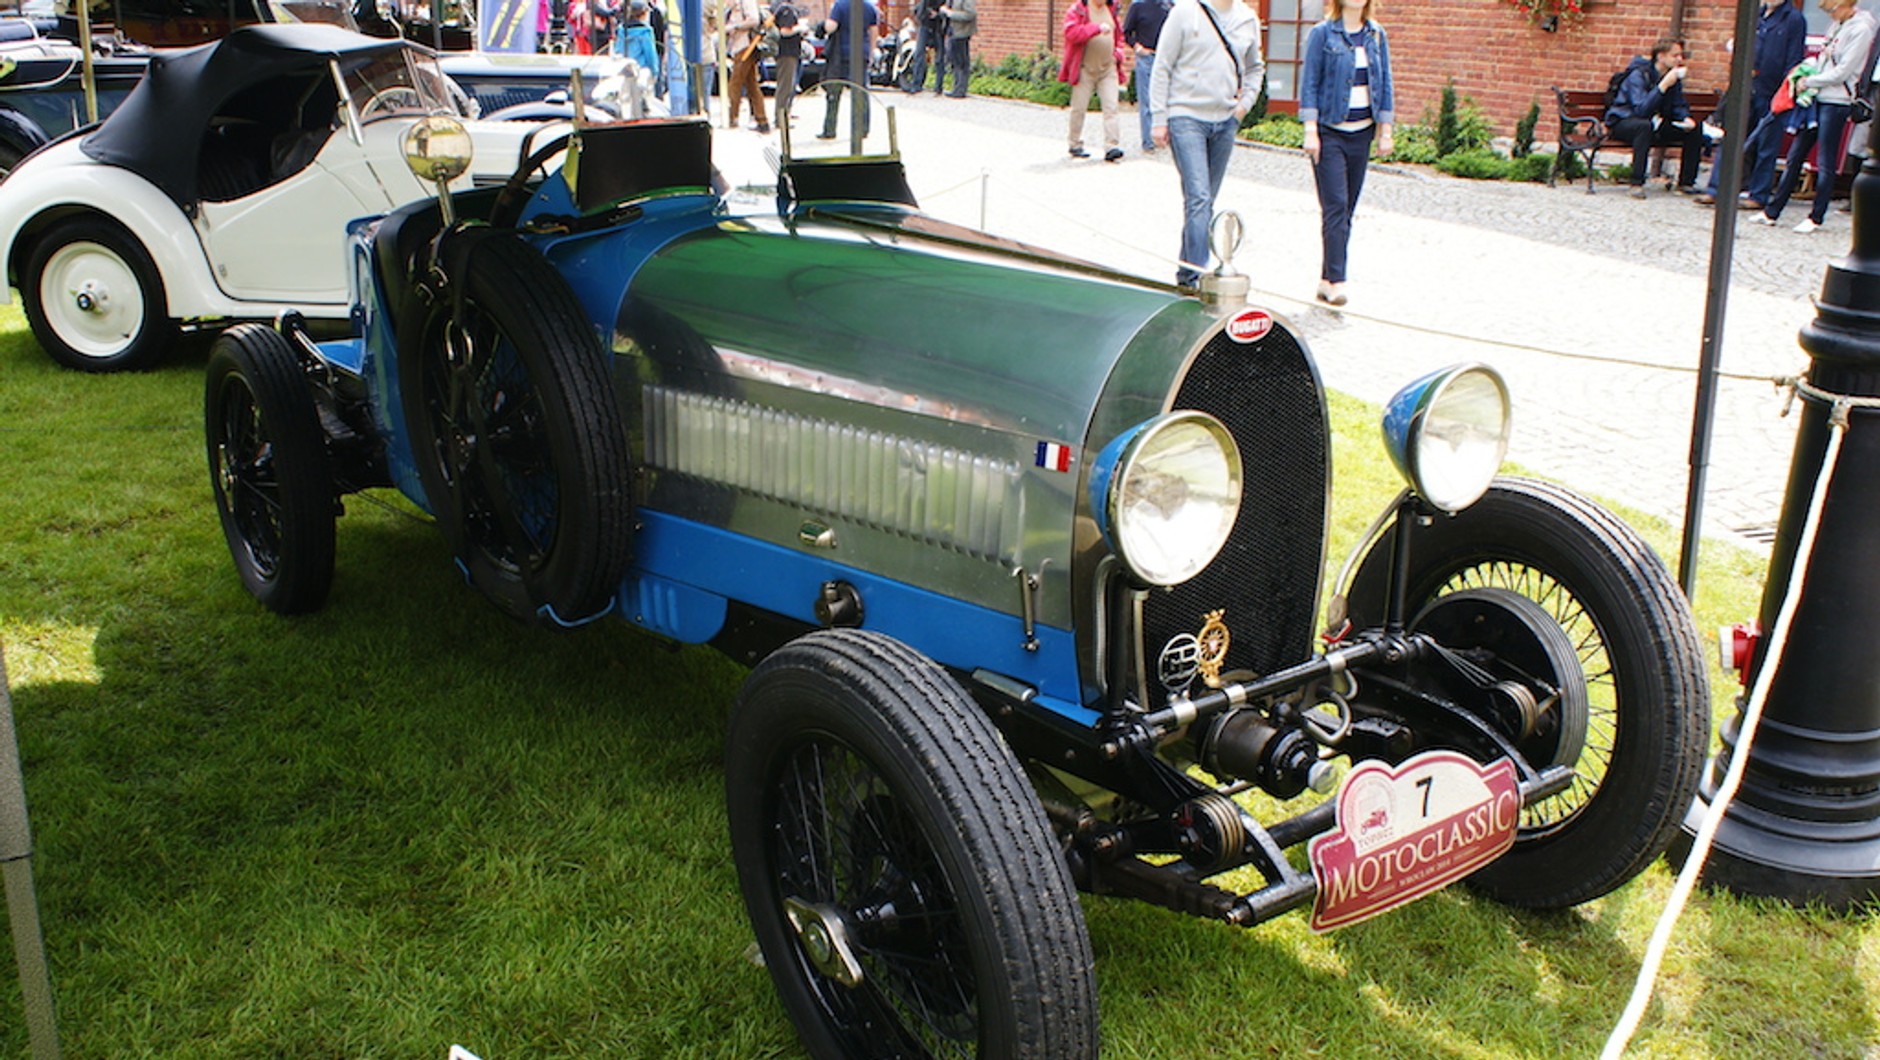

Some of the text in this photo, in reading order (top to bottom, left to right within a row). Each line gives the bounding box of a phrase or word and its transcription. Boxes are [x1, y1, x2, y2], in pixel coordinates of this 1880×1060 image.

[1231, 318, 1270, 334] BUGATTI
[1415, 775, 1434, 818] 7
[1326, 790, 1513, 909] MOTOCLASSIC
